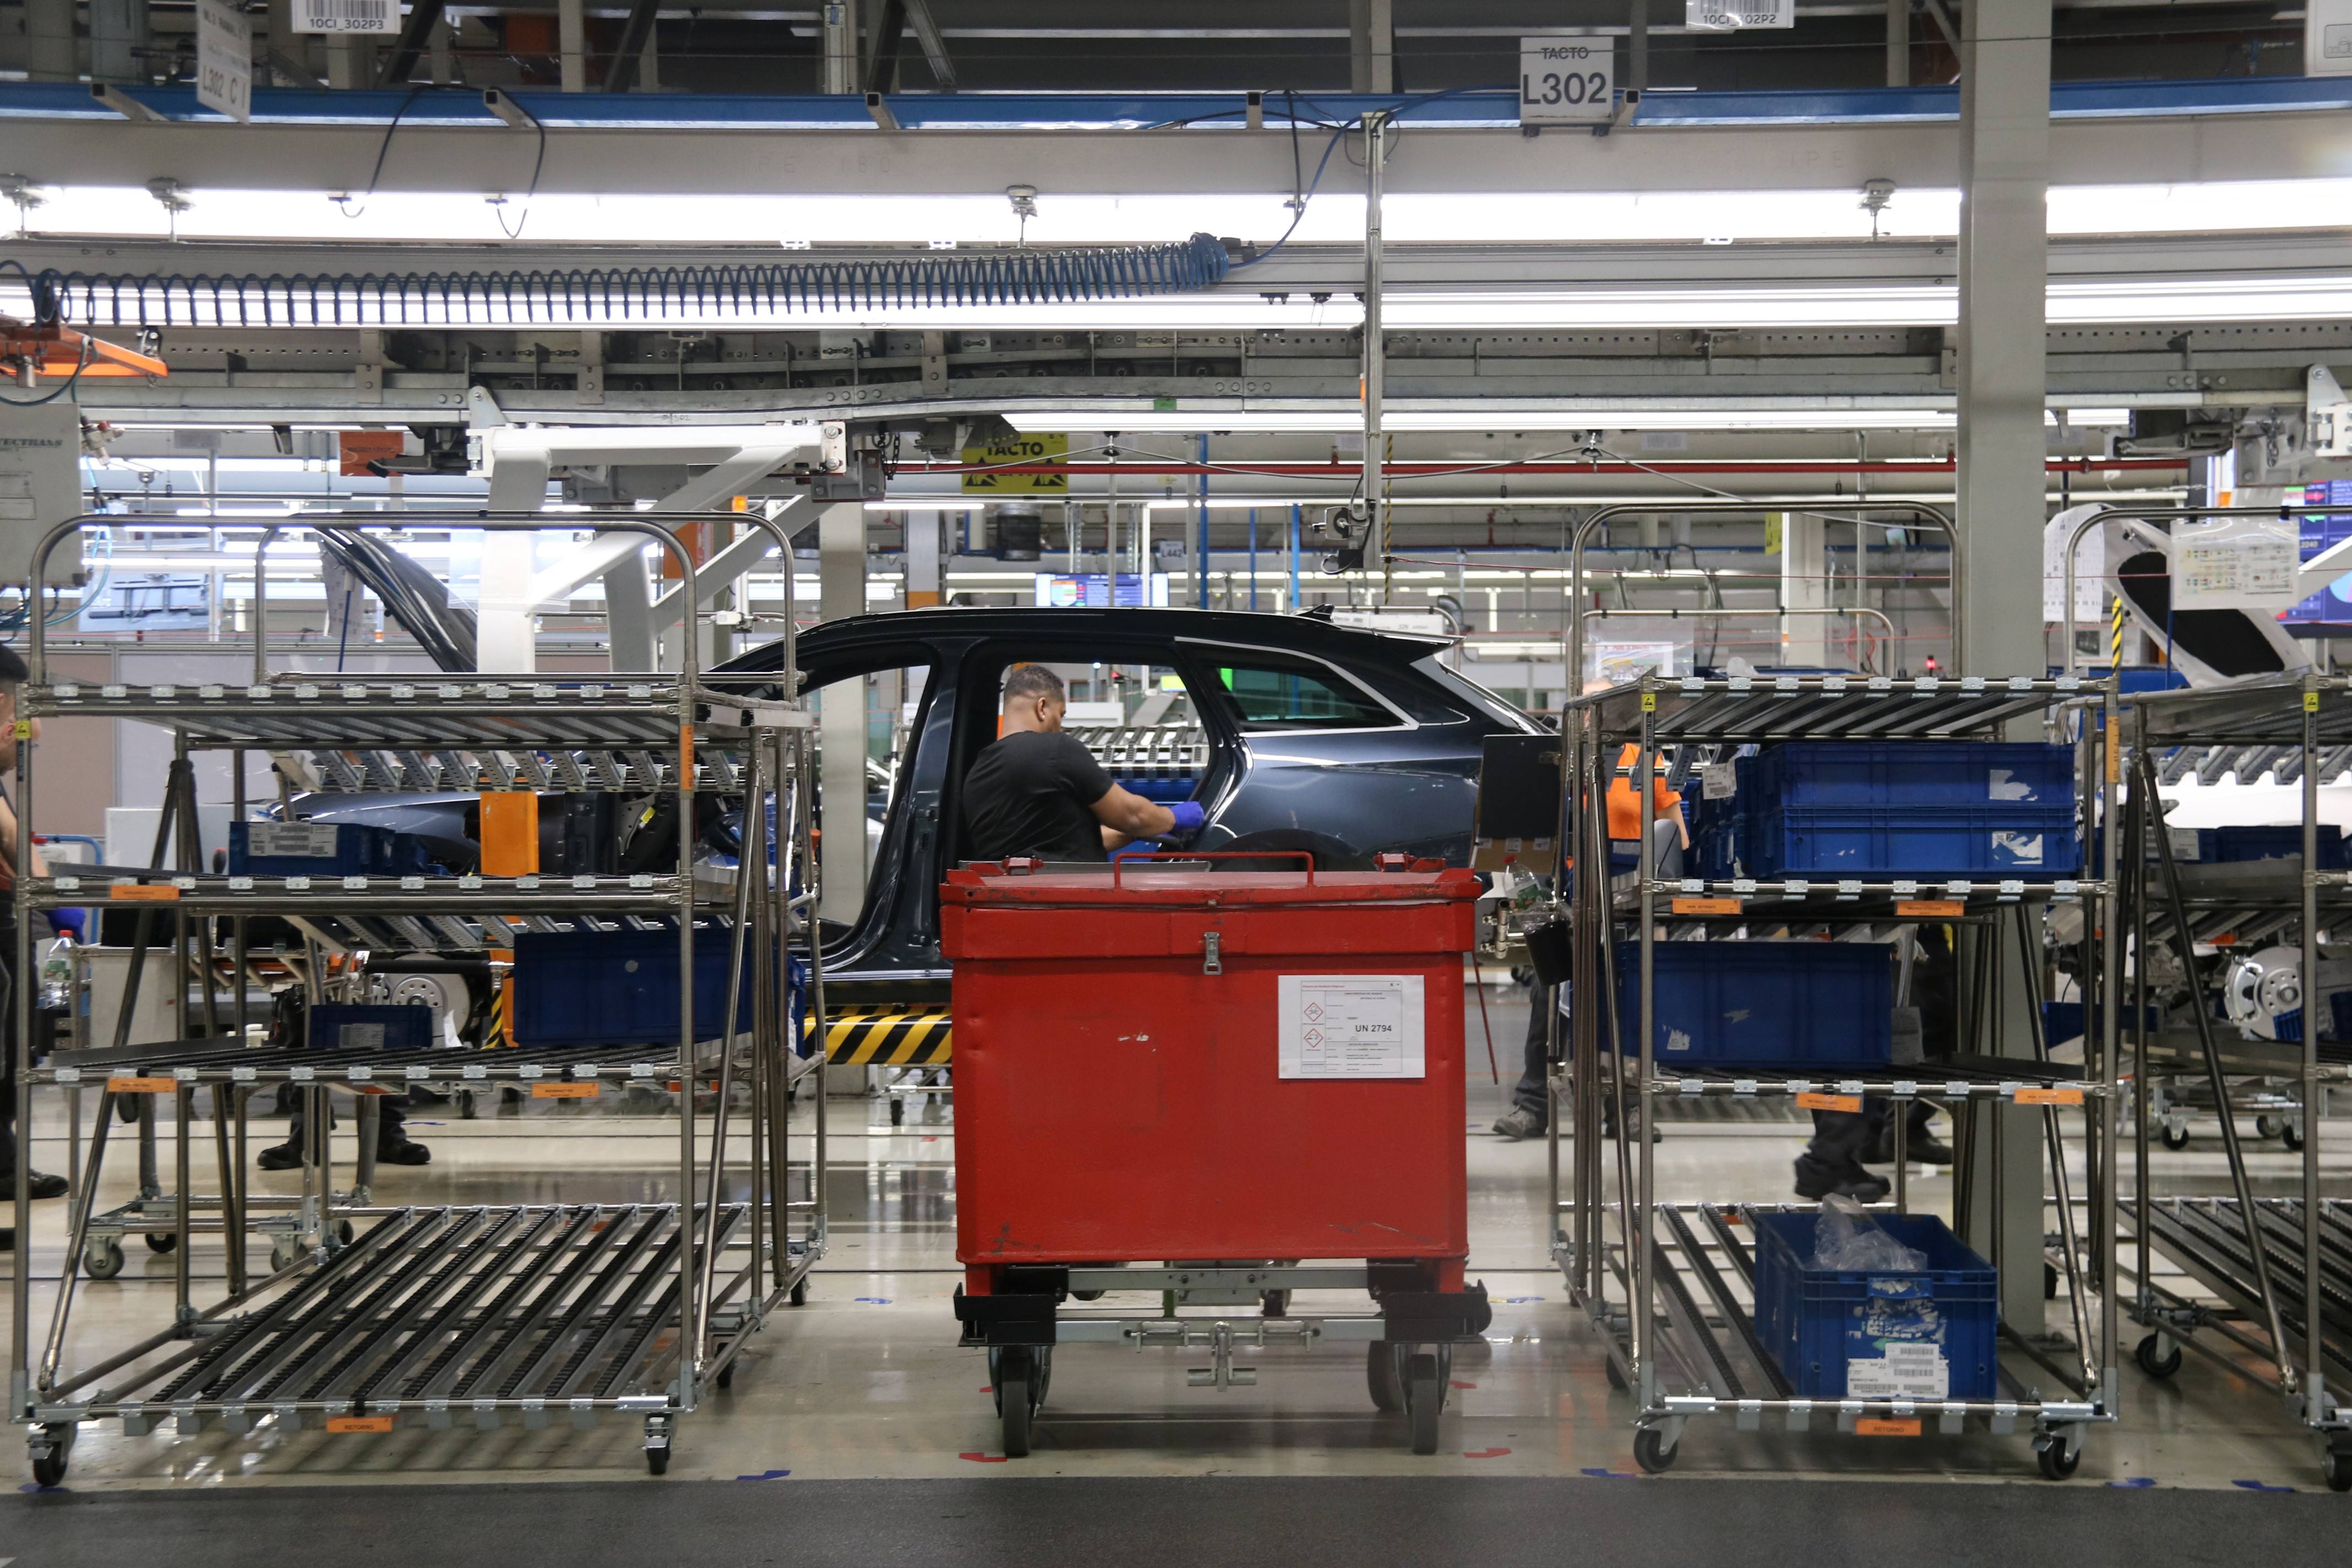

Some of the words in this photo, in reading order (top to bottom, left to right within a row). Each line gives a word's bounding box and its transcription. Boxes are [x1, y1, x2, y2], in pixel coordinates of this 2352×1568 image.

[309, 19, 384, 31] 10CI_302P3
[1540, 47, 1589, 60] TACTO
[1522, 73, 1607, 105] L302
